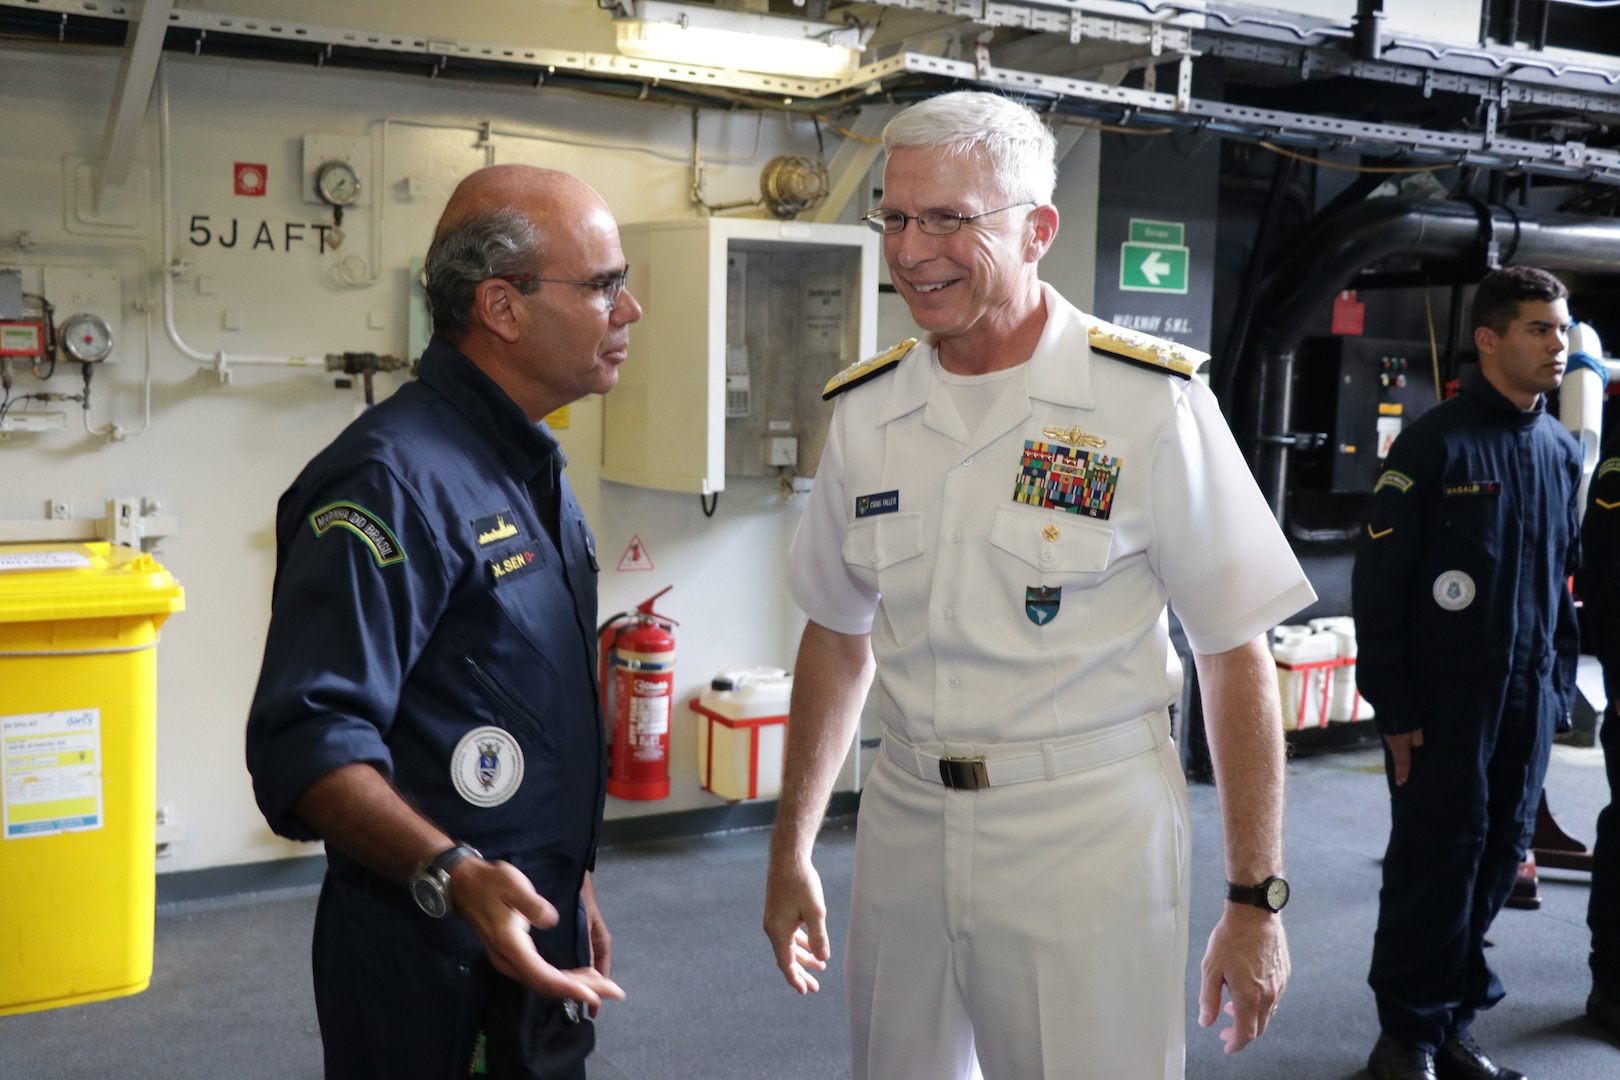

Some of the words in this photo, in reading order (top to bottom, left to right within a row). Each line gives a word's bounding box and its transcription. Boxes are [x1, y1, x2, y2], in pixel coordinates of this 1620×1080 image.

[190, 215, 238, 248] 5J
[253, 220, 333, 254] AFT
[870, 499, 882, 509] CRAIG
[349, 512, 367, 528] DO
[364, 523, 393, 559] BRASIL
